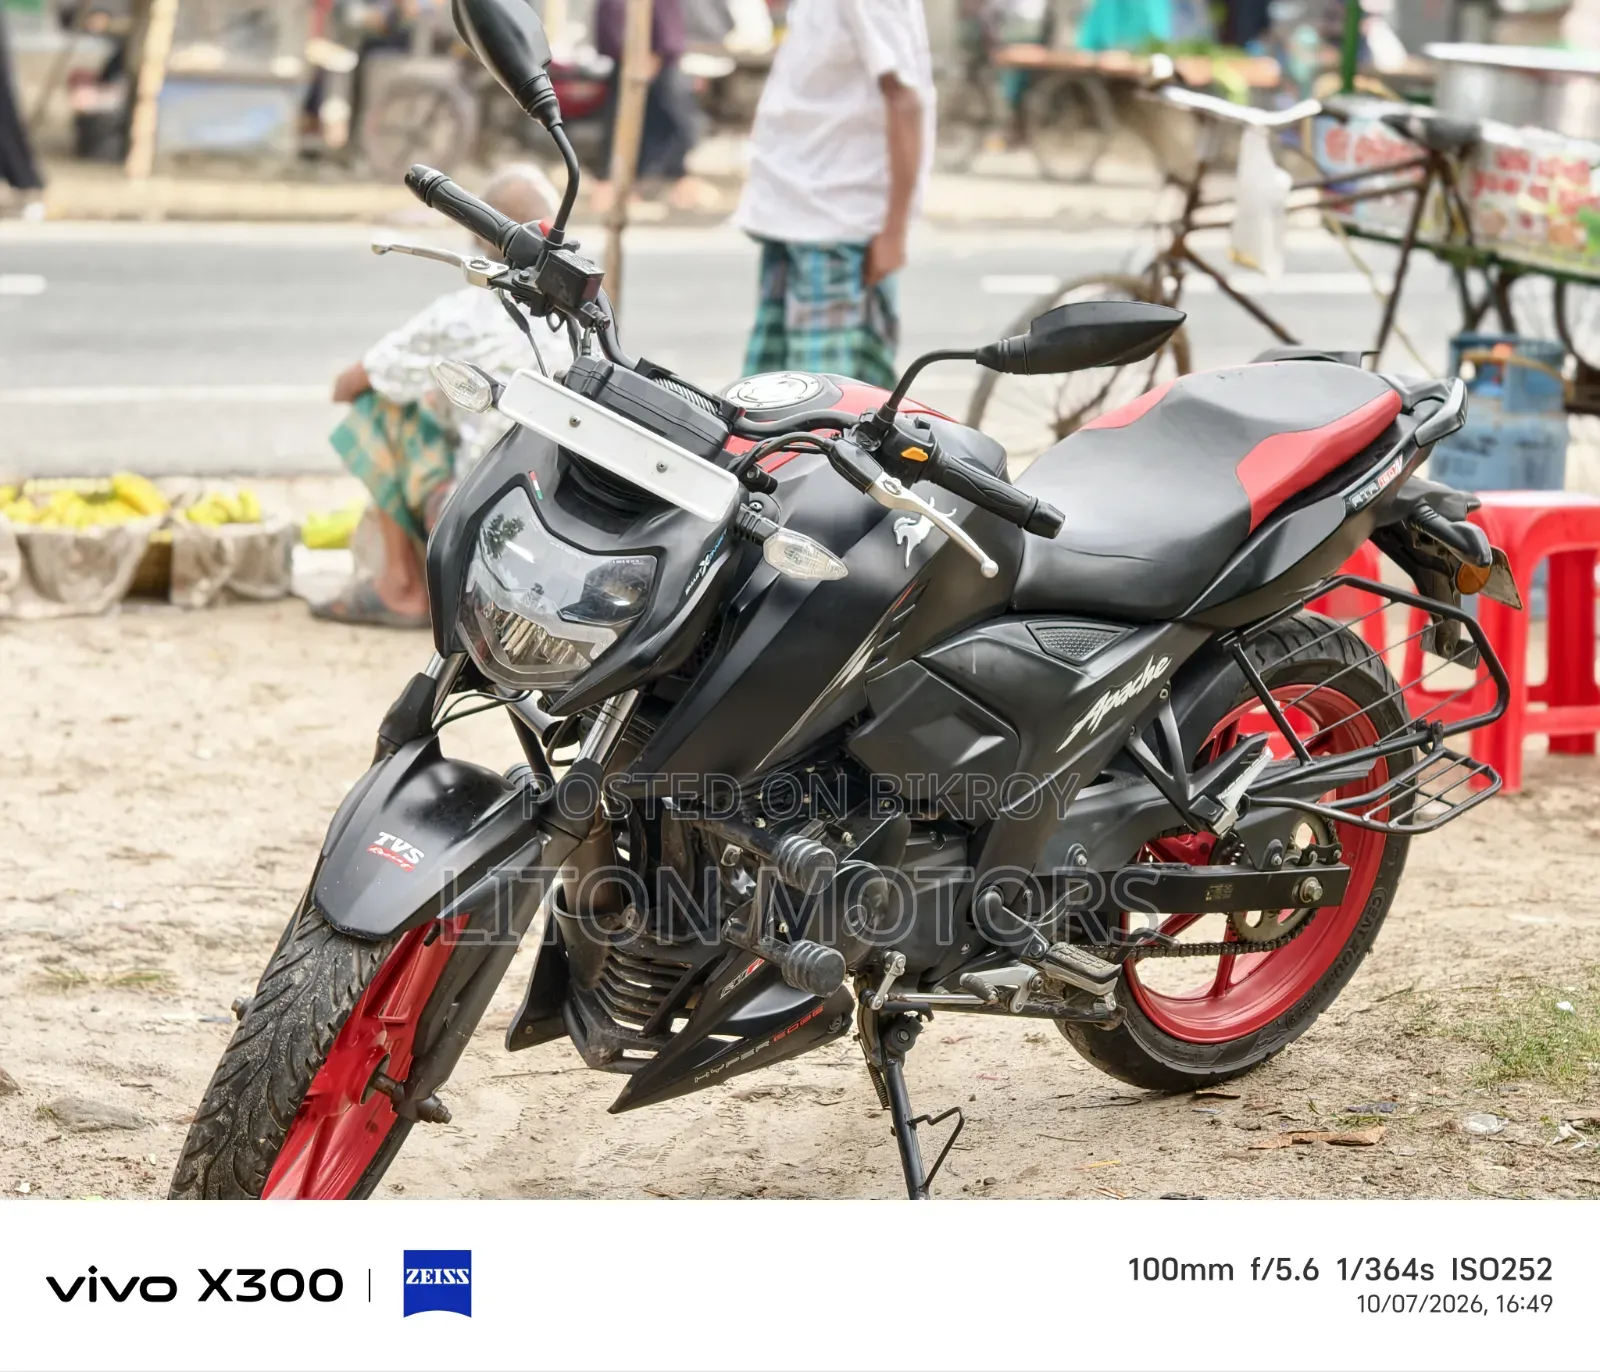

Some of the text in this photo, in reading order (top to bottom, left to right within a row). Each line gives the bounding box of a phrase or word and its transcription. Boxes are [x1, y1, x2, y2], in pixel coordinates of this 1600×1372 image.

[1055, 655, 1172, 753] Apache
[374, 831, 425, 864] TVS
[1358, 896, 1383, 939] CEAT
[694, 1040, 770, 1083] HYPER
